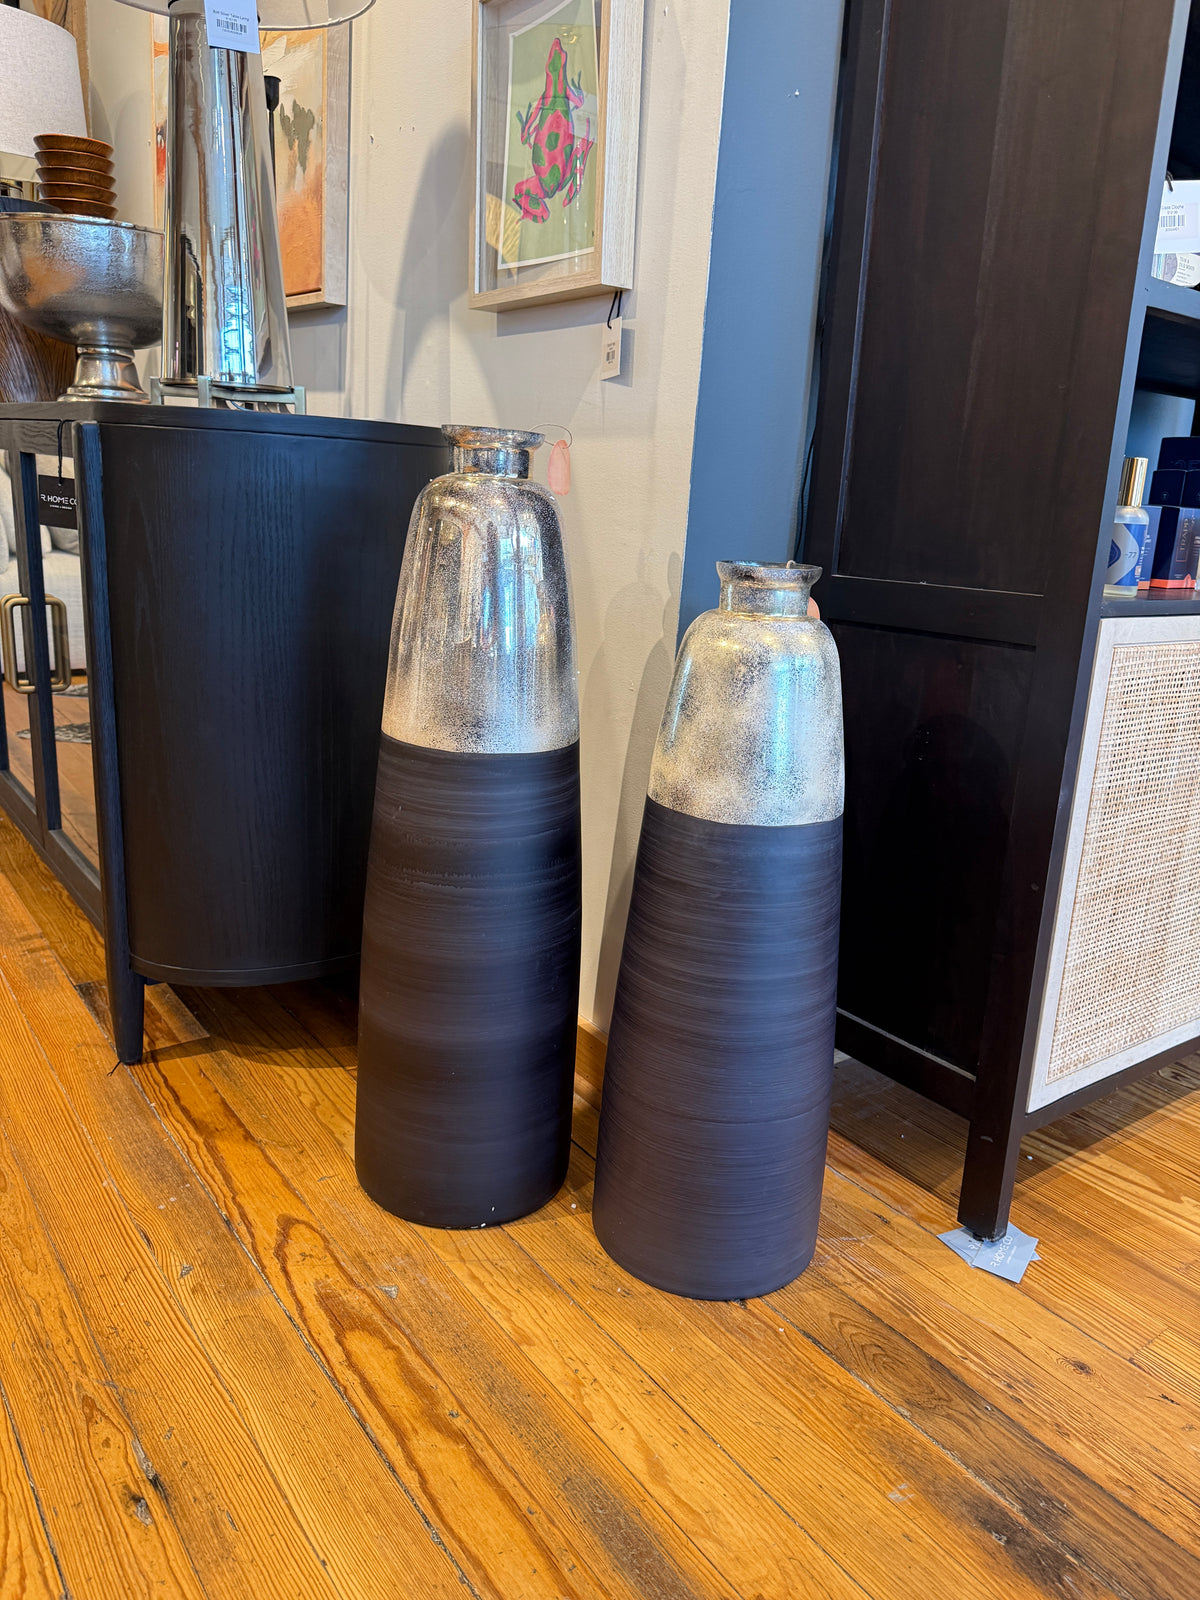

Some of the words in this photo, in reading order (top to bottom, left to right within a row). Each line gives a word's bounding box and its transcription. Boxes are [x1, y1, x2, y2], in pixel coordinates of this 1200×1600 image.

[48, 495, 69, 504] HOME
[1180, 518, 1189, 551] TRAPP
[994, 1244, 1009, 1263] HOME
